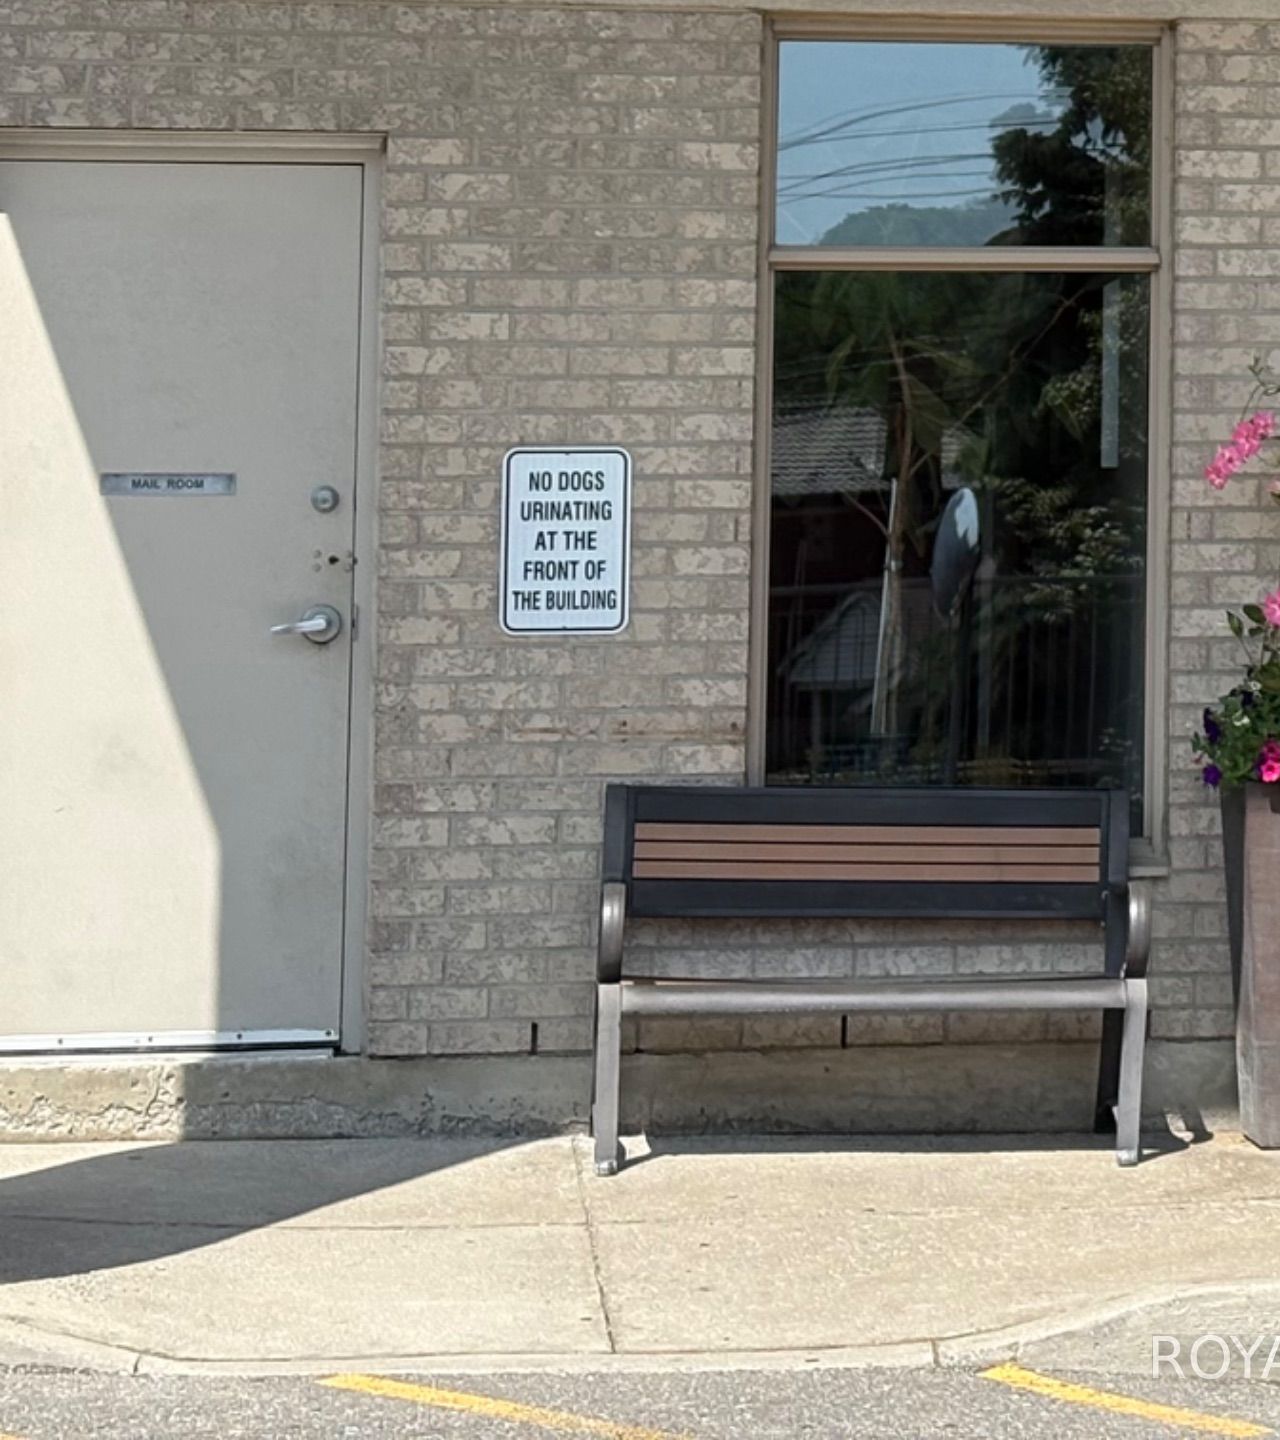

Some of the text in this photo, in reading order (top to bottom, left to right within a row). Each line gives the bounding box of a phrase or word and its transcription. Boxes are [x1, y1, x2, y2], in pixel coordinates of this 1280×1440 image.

[131, 478, 204, 489] MAIL ROOM
[529, 471, 605, 492] NO DOGS
[520, 500, 612, 522] URINATING
[535, 531, 597, 551] AT THE
[523, 560, 606, 581] FRONT OF
[512, 590, 617, 611] THE BUILDING
